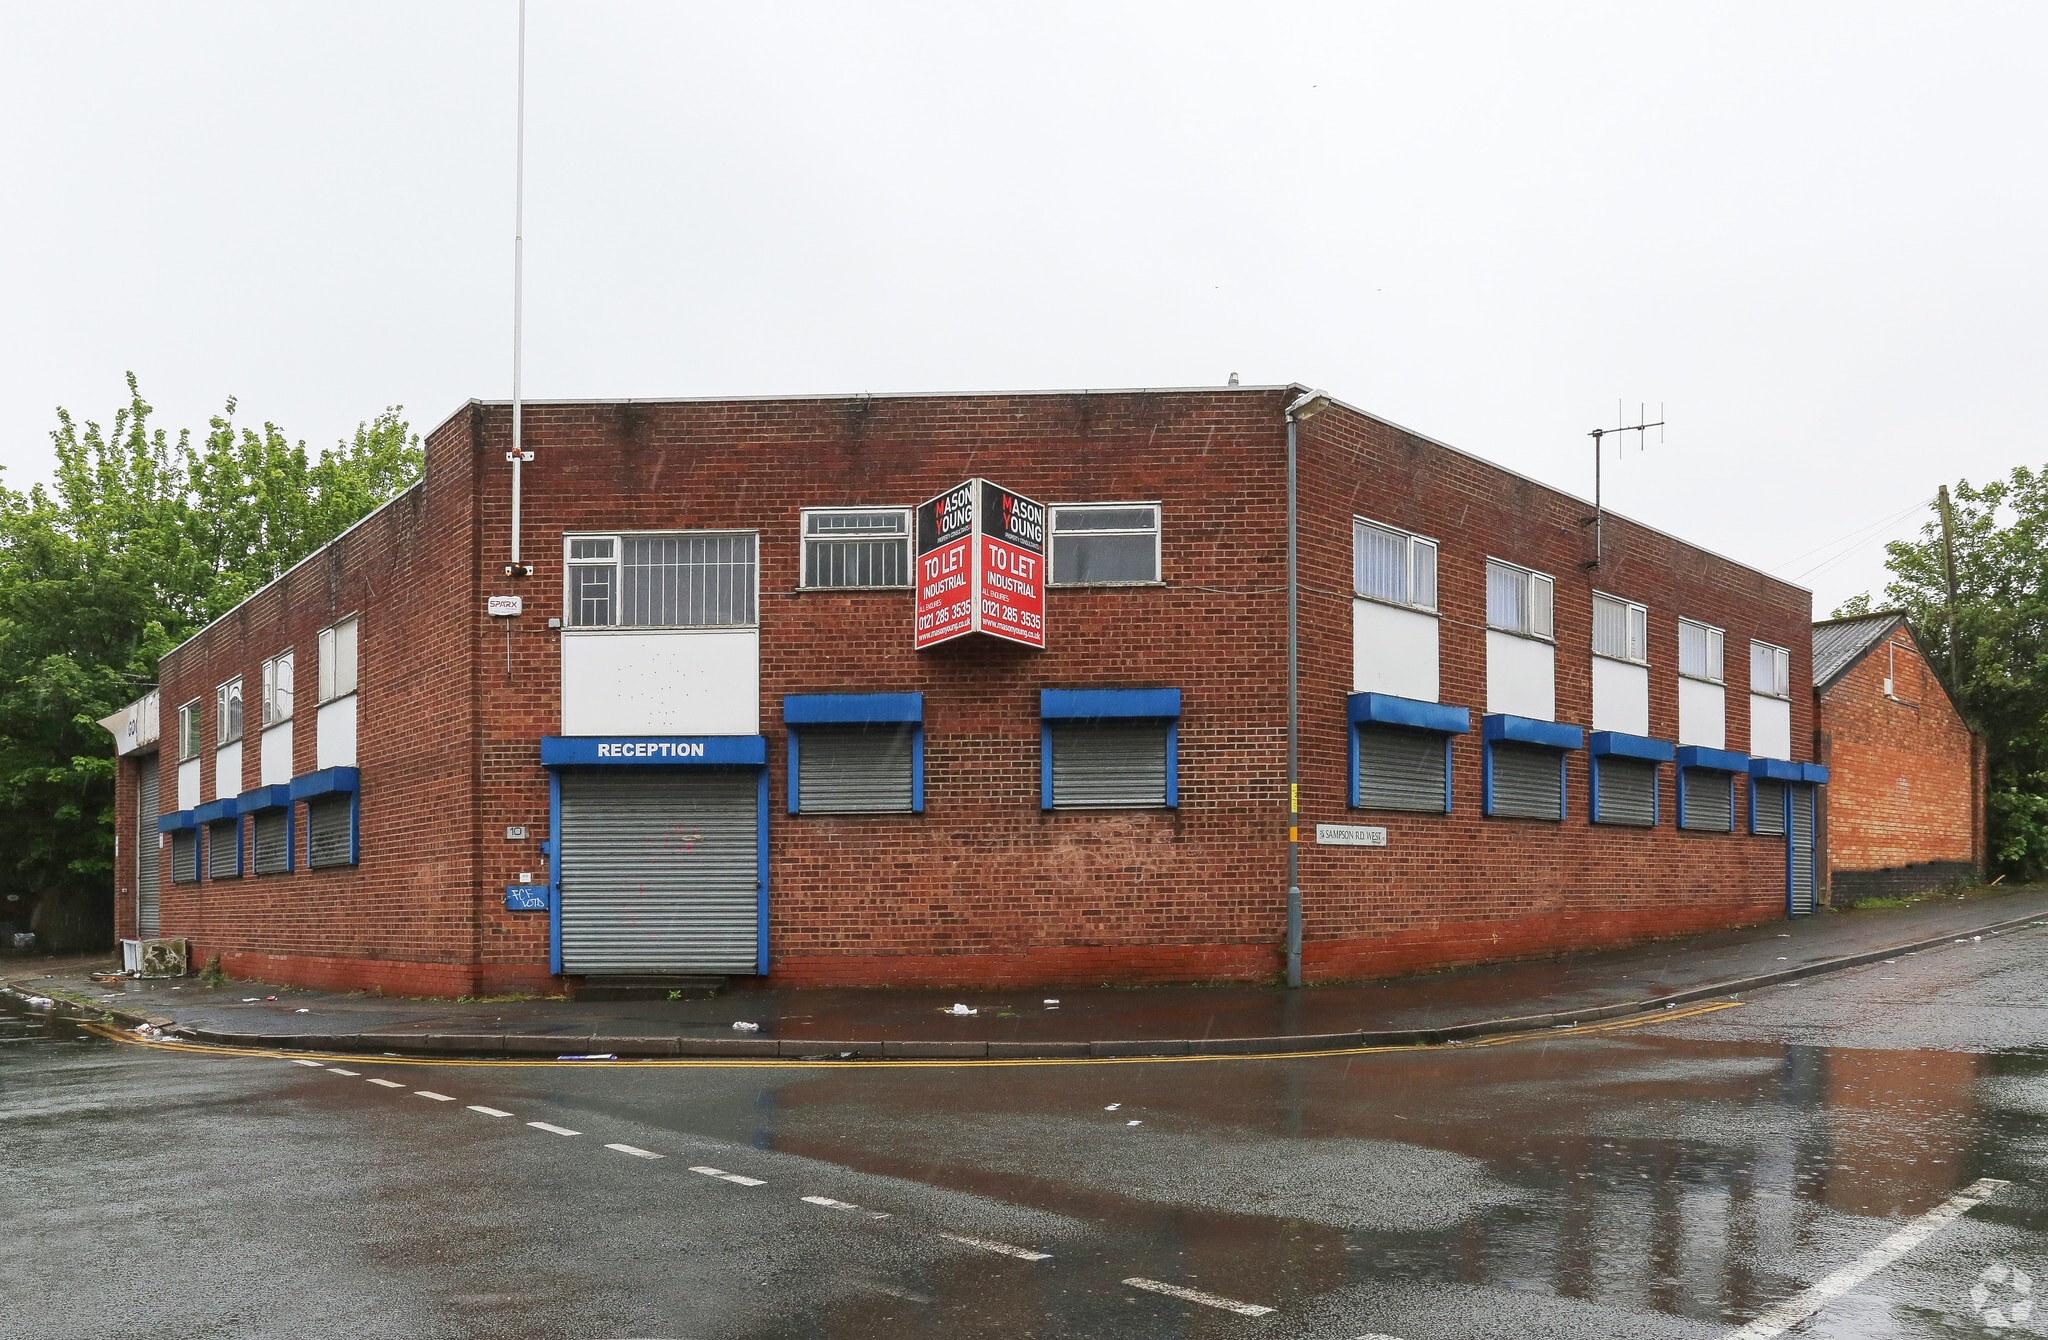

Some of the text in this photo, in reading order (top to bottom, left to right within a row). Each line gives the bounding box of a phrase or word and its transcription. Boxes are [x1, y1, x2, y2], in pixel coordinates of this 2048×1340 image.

[936, 485, 972, 518] MASON
[1002, 493, 1042, 525] MASON
[936, 505, 972, 535] YOUNG
[1003, 512, 1042, 542] YOUNG
[924, 545, 966, 580] TO LET
[989, 544, 1036, 579] TO LET
[923, 572, 966, 600] INDUSTRIAL
[982, 587, 990, 597] ALL
[987, 570, 1036, 599] INDUSTRIAL
[489, 600, 517, 608] SPARX
[919, 599, 971, 630] 0121 285 3535
[982, 599, 1041, 630] 0121 285 3535
[918, 617, 971, 641] www.masonyoung.co.uk
[981, 618, 1040, 640] www.masonyoung.co.uk
[598, 743, 704, 757] RECEPTION
[509, 827, 522, 836] 10
[1325, 829, 1354, 840] SAMPSON
[1366, 831, 1382, 841] WEST
